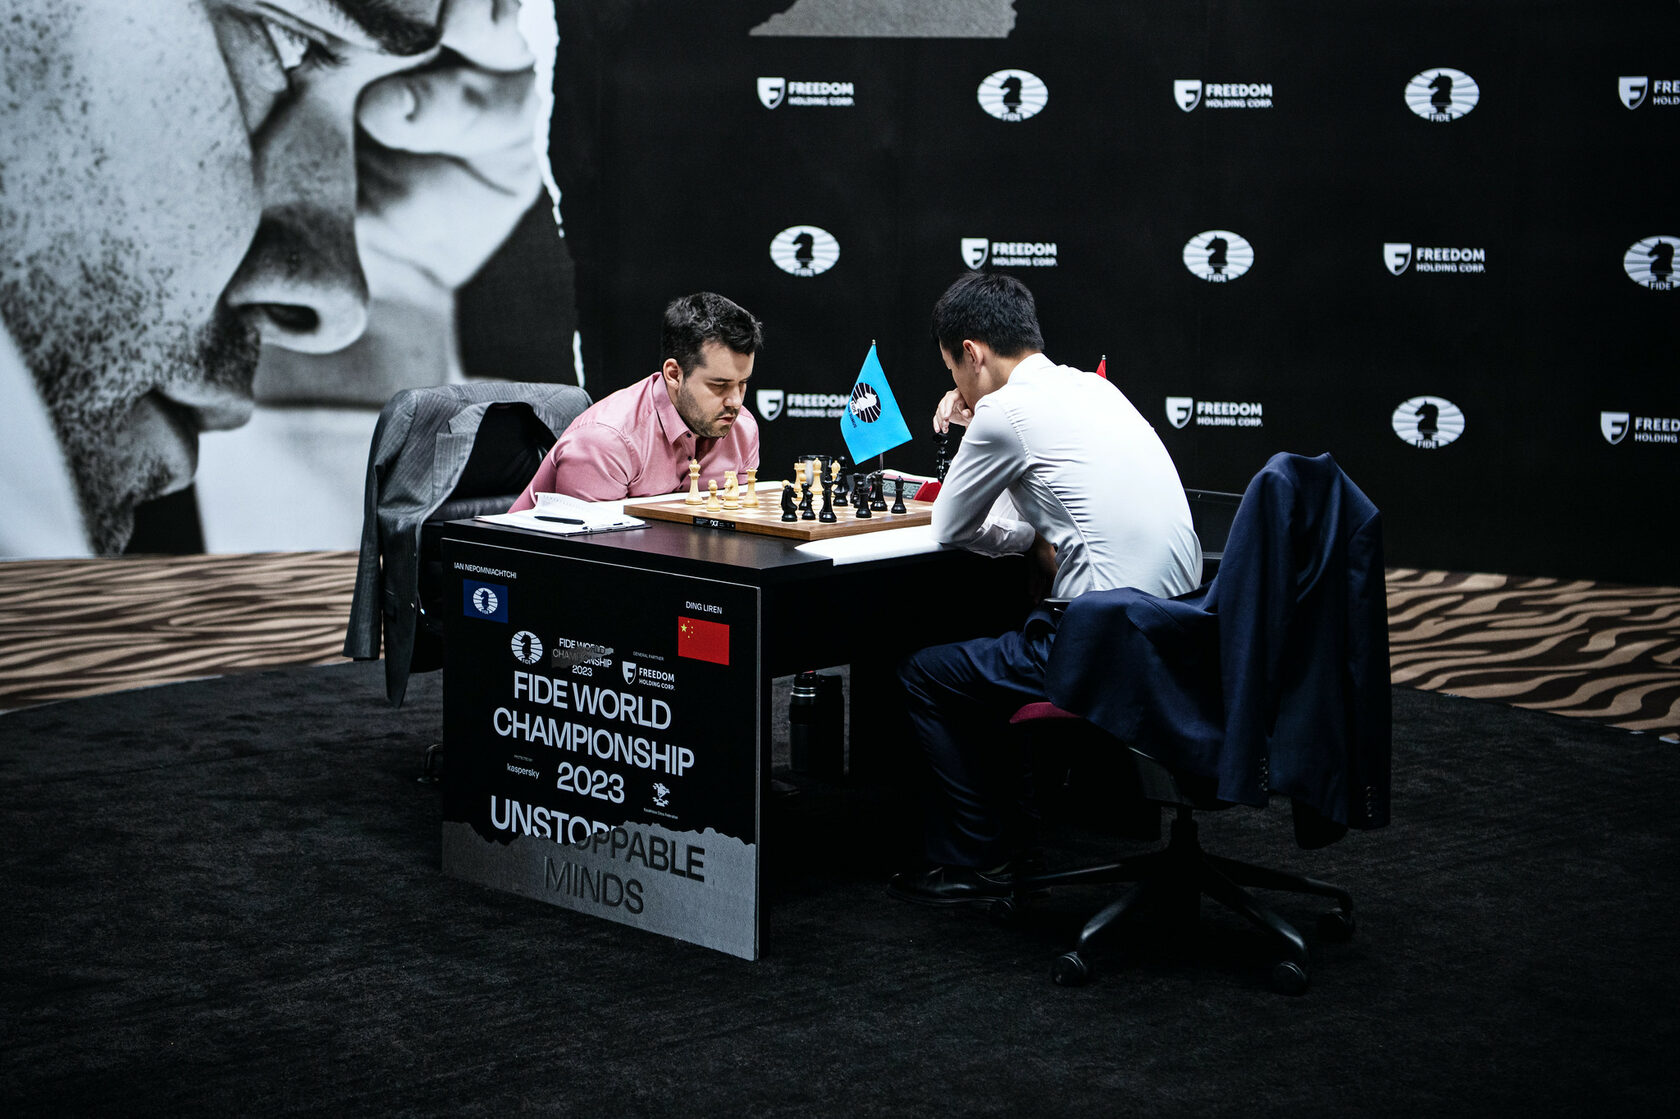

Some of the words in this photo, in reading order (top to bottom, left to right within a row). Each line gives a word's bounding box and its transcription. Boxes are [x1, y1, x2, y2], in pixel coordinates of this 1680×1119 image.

[788, 82, 854, 96] FREEDOM
[1205, 83, 1273, 97] FREEDOM
[1204, 98, 1246, 108] HOLDING
[1653, 96, 1680, 105] HOLD
[1430, 113, 1451, 122] FIDE
[991, 242, 1057, 256] FREEDOM
[1416, 247, 1485, 262] FREEDOM
[1416, 262, 1457, 272] HOLDING
[1208, 273, 1227, 283] FIDE
[1650, 281, 1671, 291] FIDE
[1197, 401, 1262, 416] FREEDOM
[1196, 416, 1236, 426] HOLDING
[1635, 416, 1680, 432] FREED
[1417, 439, 1437, 449] FIDE
[1634, 432, 1678, 443] HOLDING
[453, 562, 465, 570] IAN
[465, 563, 517, 579] NEPOMNIACHTCHI
[685, 600, 702, 611] DING
[703, 604, 723, 614] LIREN
[559, 637, 576, 649] FIDE
[552, 648, 612, 667] CHAMONSHIP
[572, 664, 593, 677] 2023
[639, 667, 675, 682] FREEDOM
[639, 678, 660, 688] HOLDING
[514, 670, 568, 709] FIDE
[572, 682, 672, 730] WORLD
[493, 706, 695, 777] CHAMPIONSHIP
[507, 762, 540, 779] kaspersky
[556, 761, 625, 804] 2023
[491, 795, 705, 883] UNSTOPPABLE
[544, 856, 644, 915] MINDS
